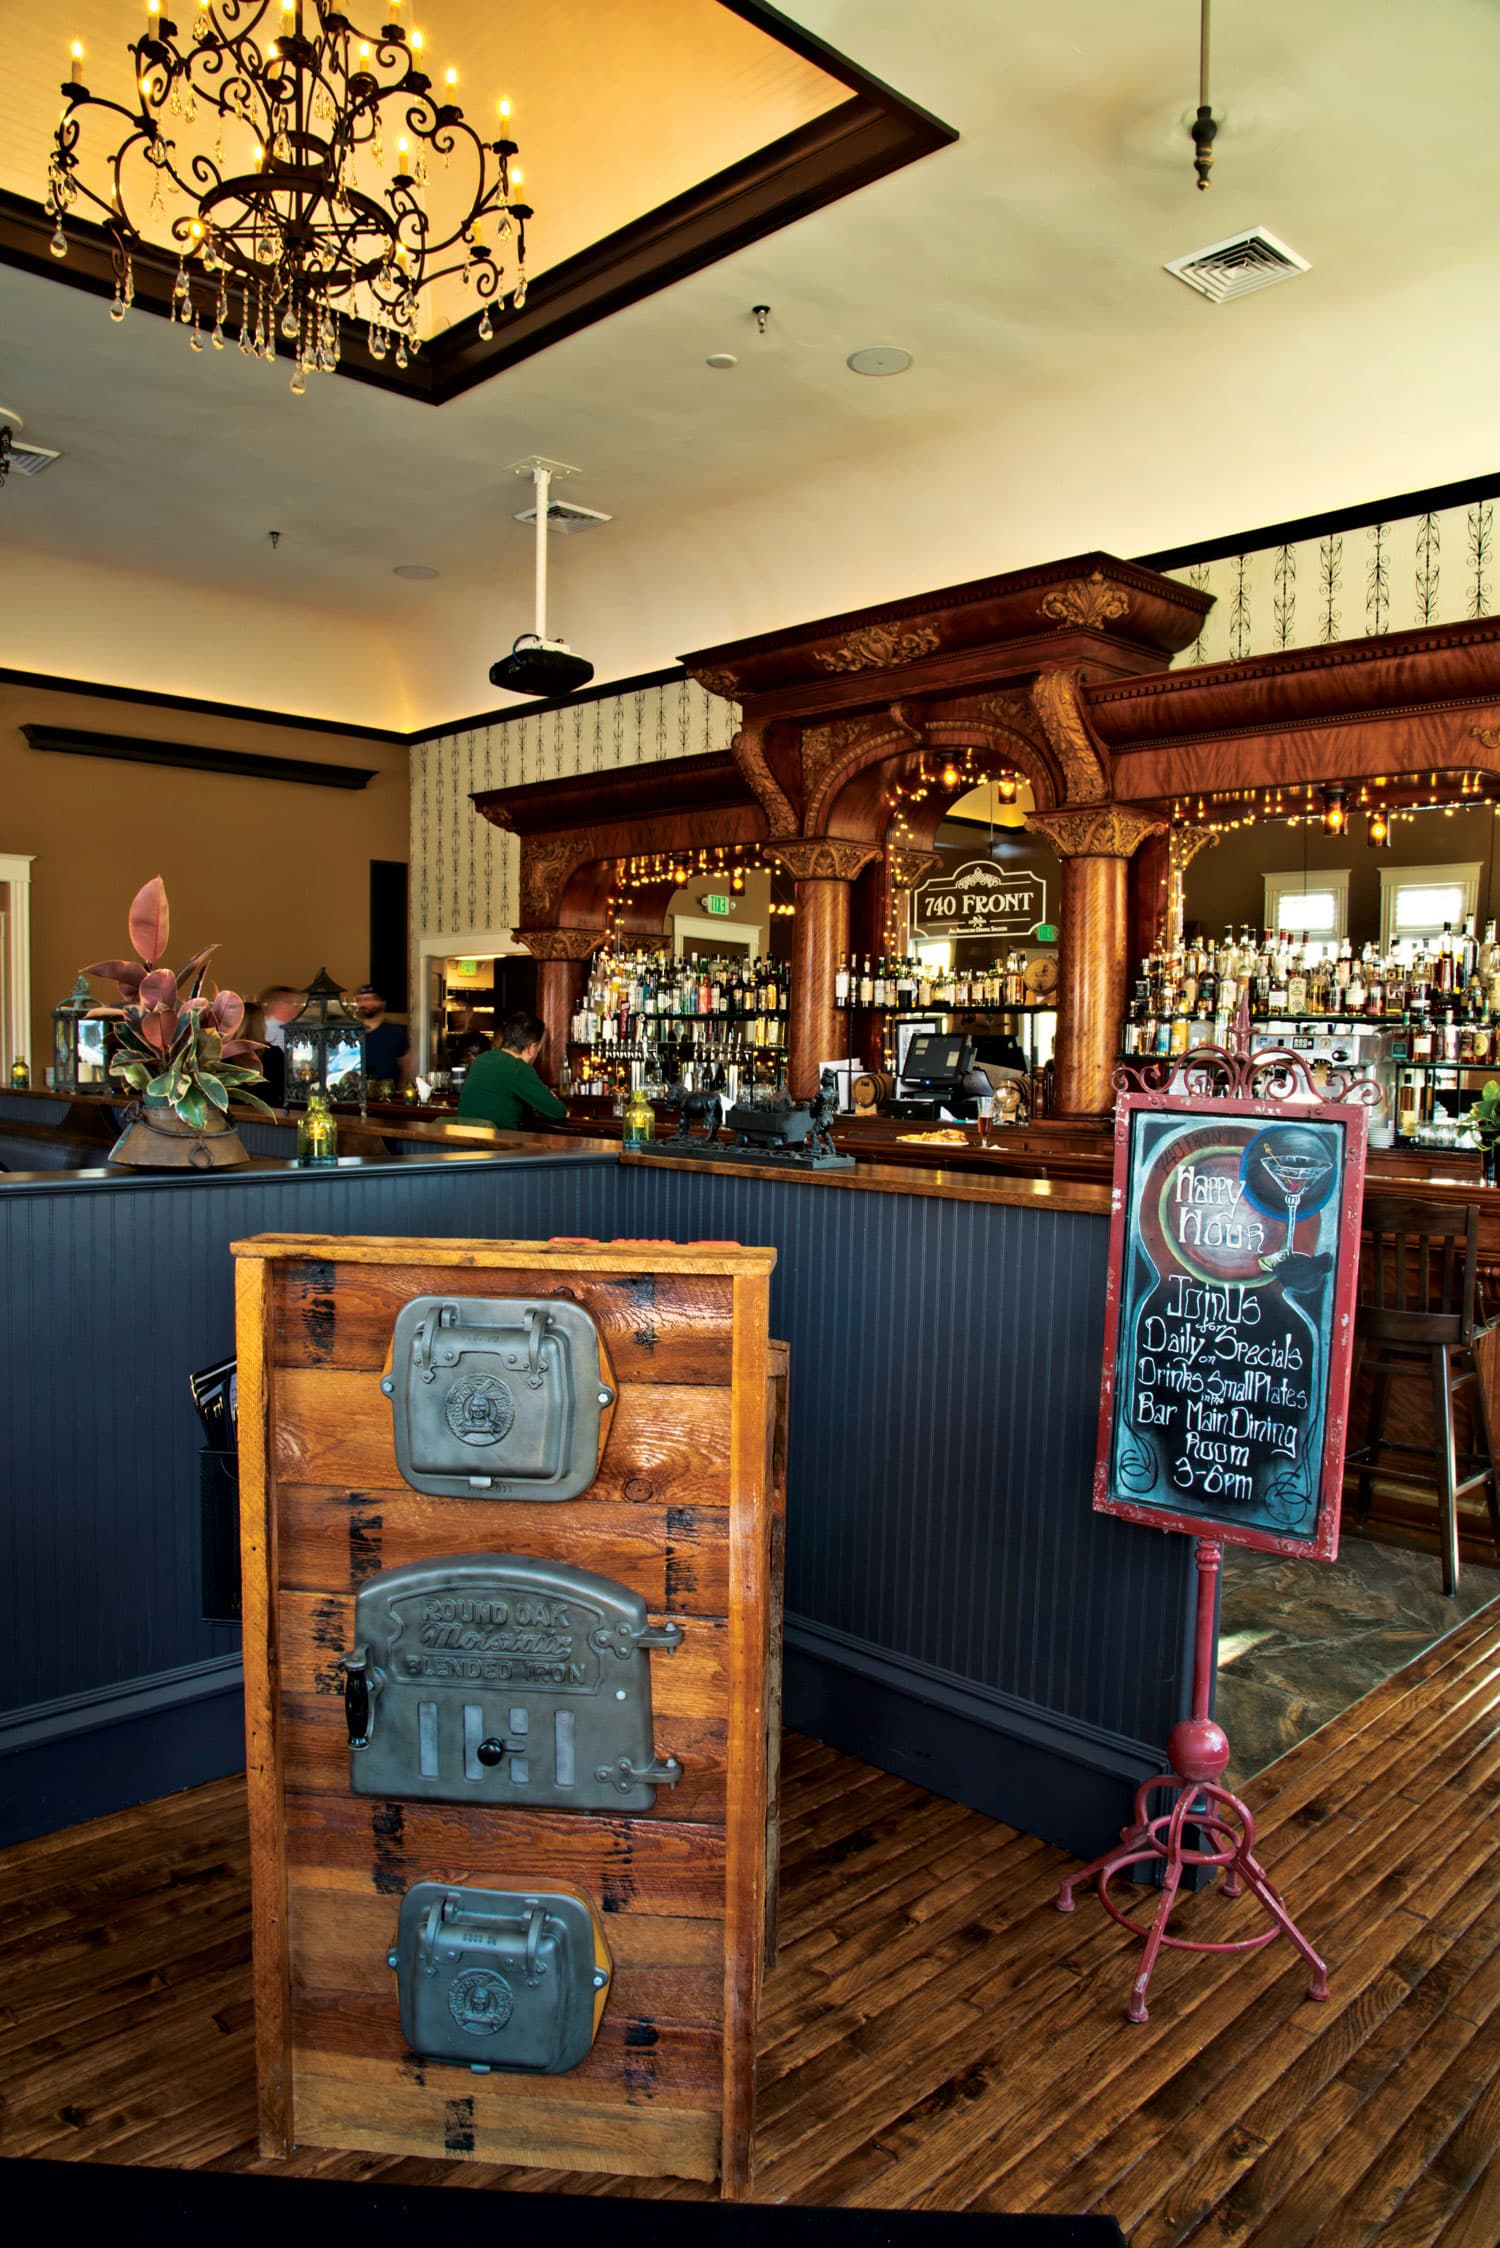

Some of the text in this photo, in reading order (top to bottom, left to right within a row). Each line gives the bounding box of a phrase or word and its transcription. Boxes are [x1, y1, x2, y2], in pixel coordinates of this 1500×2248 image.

[924, 892, 1034, 917] 740 FRONT
[1195, 1318, 1227, 1333] for
[1143, 1316, 1303, 1370] Daily Specials
[1199, 1354, 1216, 1365] on
[1138, 1356, 1308, 1409] Drinks Small Plates
[1137, 1392, 1298, 1459] Bar Main Dining
[1186, 1431, 1250, 1467] Room
[423, 1600, 571, 1628] ROUND OAK
[406, 1655, 587, 1684] BLENDED IRON
